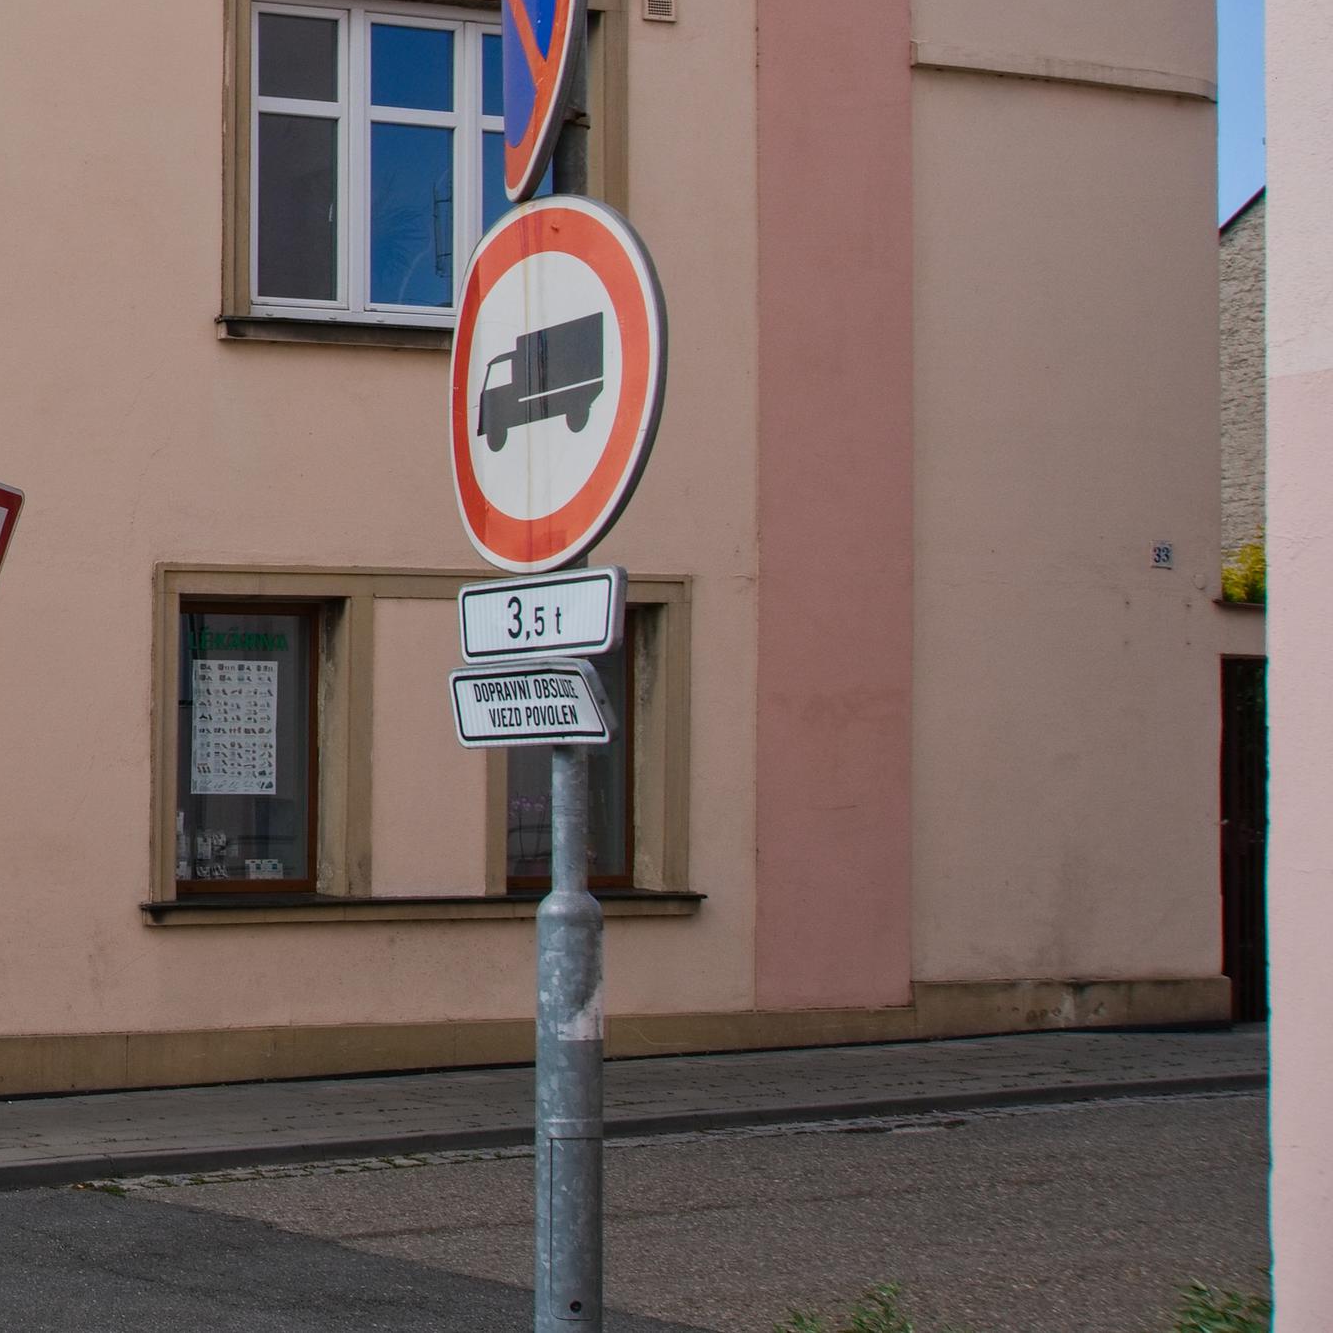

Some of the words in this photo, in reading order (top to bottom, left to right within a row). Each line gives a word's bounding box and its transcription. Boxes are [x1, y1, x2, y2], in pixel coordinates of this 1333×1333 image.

[1153, 546, 1170, 563] 33
[507, 596, 545, 641] 3,5
[555, 606, 562, 634] t
[473, 675, 532, 703] DOPRAVNÍ
[533, 677, 579, 700] OBSLUZE
[489, 706, 523, 728] VJEZD
[525, 704, 579, 727] POVOLEN
